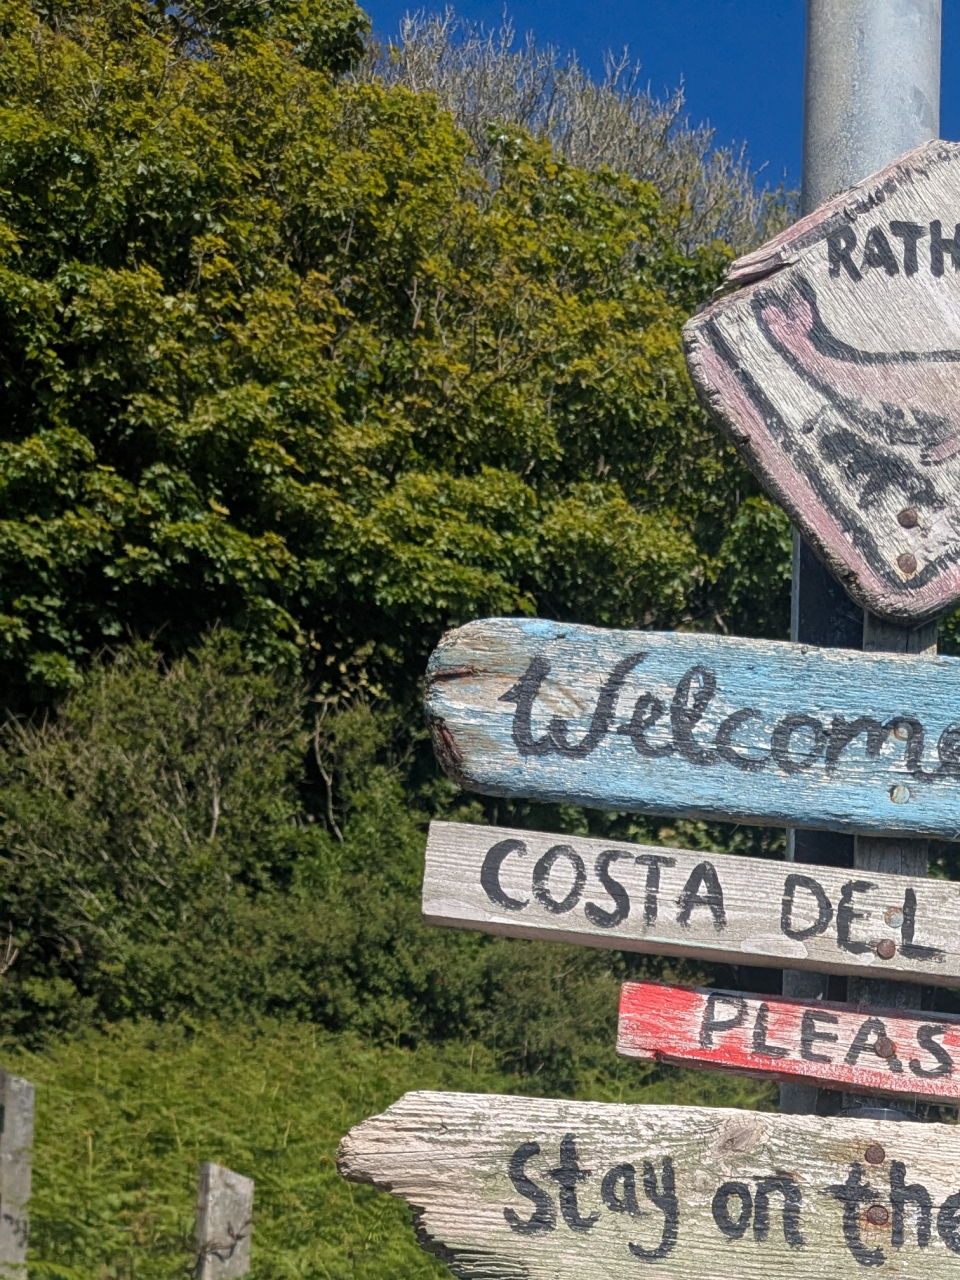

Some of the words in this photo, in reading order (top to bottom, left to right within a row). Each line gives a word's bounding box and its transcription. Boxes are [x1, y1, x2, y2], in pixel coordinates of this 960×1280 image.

[480, 838, 728, 933] COSTA
[781, 873, 946, 964] DEL
[503, 1133, 679, 1261] Stay
[711, 1173, 804, 1248] on
